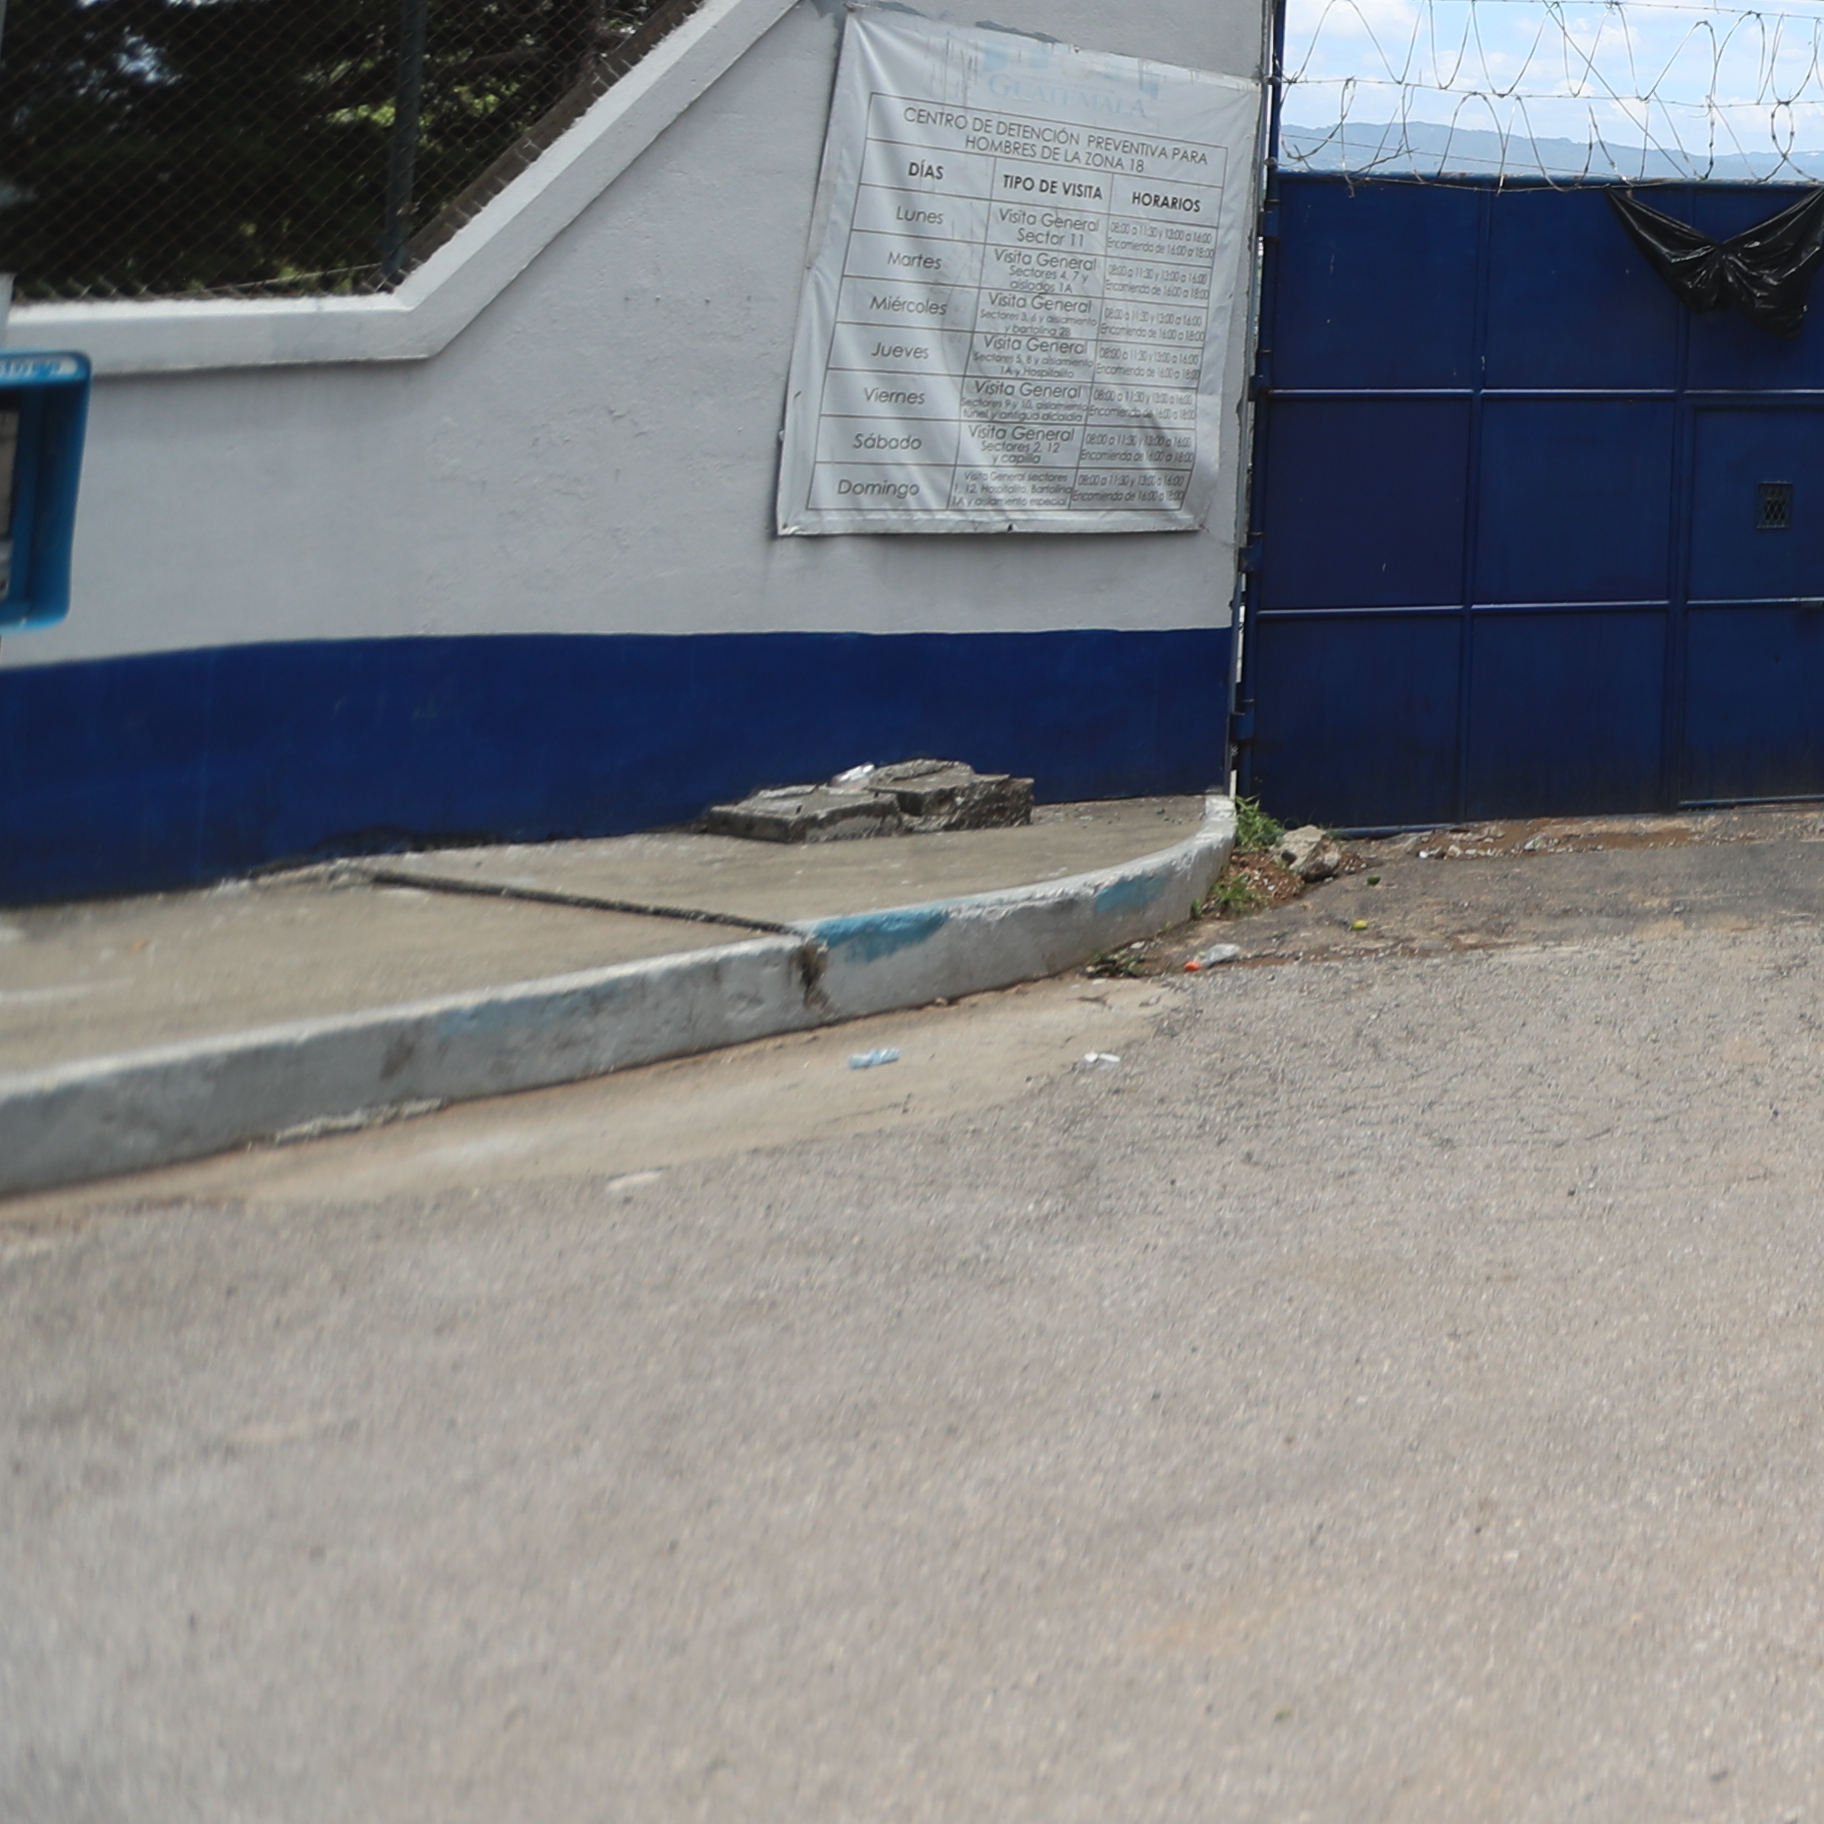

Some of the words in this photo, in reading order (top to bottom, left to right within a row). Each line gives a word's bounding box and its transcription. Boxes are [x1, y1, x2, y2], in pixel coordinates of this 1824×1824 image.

[903, 107, 968, 130] CENTRO
[973, 117, 992, 133] DE
[996, 121, 1080, 145] DETENCIÓN
[1088, 135, 1167, 159] PREVENTIVA
[1172, 148, 1208, 165] PARA
[965, 135, 1037, 158] HOMBRES
[1041, 146, 1059, 161] DE
[1064, 148, 1080, 162] LA
[1085, 152, 1124, 170] ZONA
[1130, 159, 1144, 173] 18
[908, 159, 944, 179] DÍAS
[1003, 174, 1034, 191] TIPO
[1039, 179, 1058, 194] DE
[1062, 182, 1102, 200] VISITA
[1132, 191, 1201, 212] HORARIOS
[896, 206, 944, 224] Lunes
[999, 208, 1037, 225] Visita
[1041, 213, 1099, 232] General
[1017, 228, 1065, 245] Sector
[1071, 234, 1084, 246] 11
[887, 251, 942, 270] Martes
[995, 248, 1031, 265] Visita
[1037, 252, 1097, 270] General
[1009, 265, 1057, 279] Sectores
[1073, 272, 1079, 281] 7
[1082, 275, 1089, 283] y
[1010, 280, 1055, 292] aislados
[1060, 282, 1073, 293] 1A
[870, 295, 947, 315] Miércoles
[989, 292, 1027, 308] Visita
[1031, 295, 1092, 313] General
[871, 342, 929, 359] Jueves
[984, 335, 1022, 350] Visita
[1026, 337, 1087, 354] General
[864, 388, 925, 405] Viernes
[975, 380, 1015, 395] Visita
[1020, 382, 1082, 398] General
[853, 433, 922, 450] Sábado
[968, 424, 1007, 439] Visita
[1012, 426, 1074, 442] General
[982, 440, 1030, 452] Sectores
[1048, 443, 1060, 453] 12
[838, 479, 919, 499] Domingo
